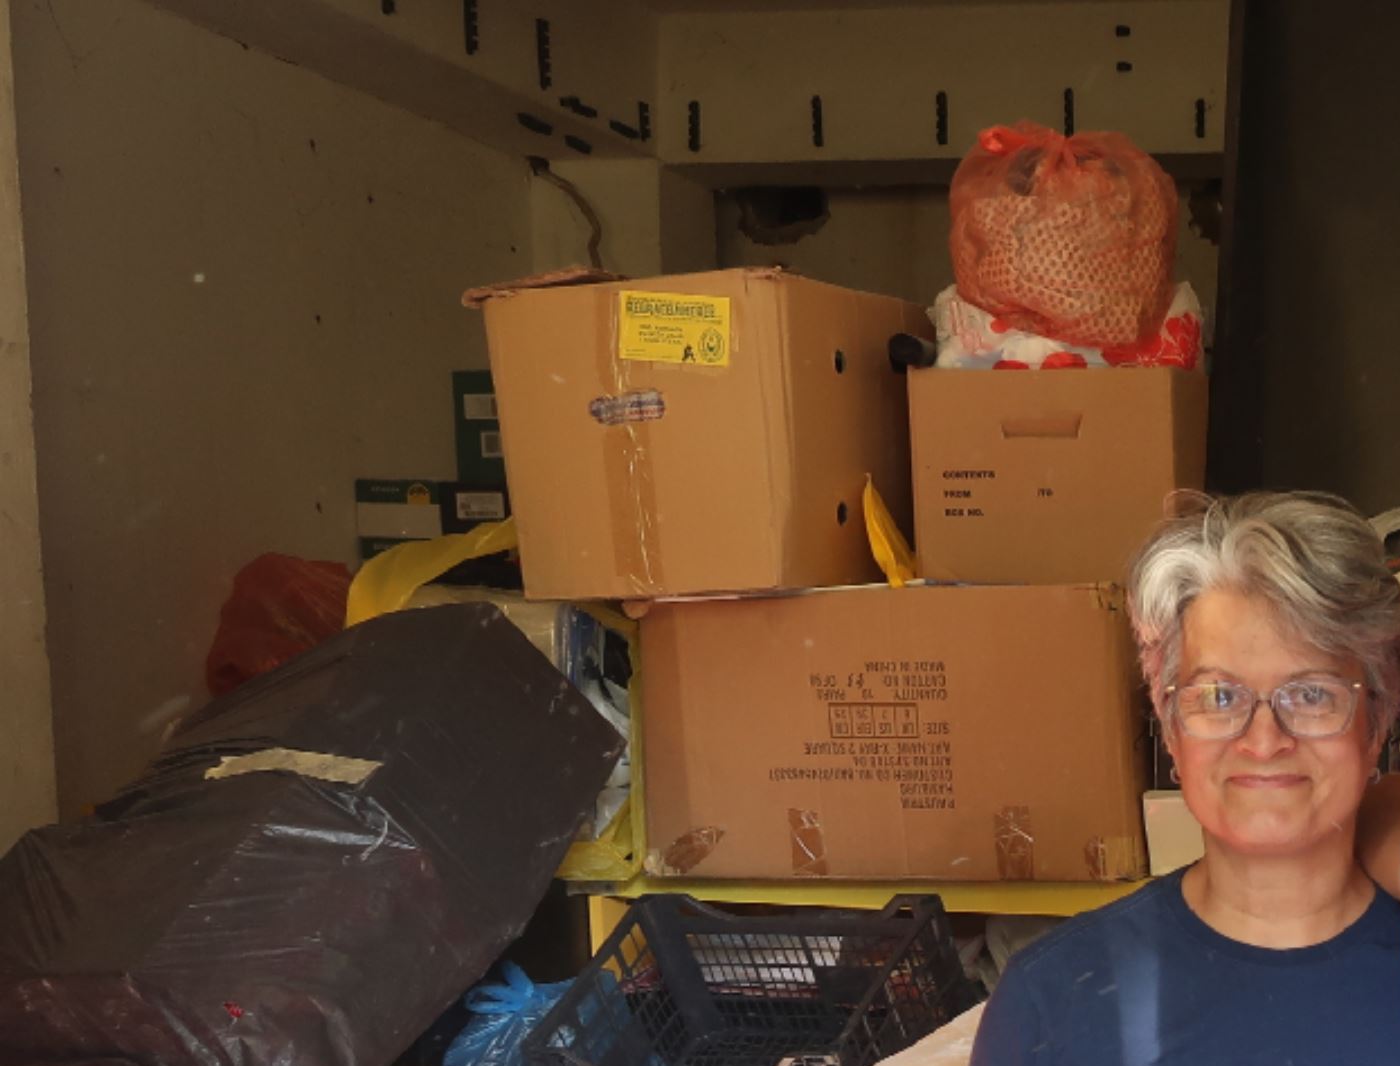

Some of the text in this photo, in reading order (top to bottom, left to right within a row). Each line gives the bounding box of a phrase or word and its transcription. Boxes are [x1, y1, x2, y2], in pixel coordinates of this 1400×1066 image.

[944, 490, 971, 498] FROM
[865, 661, 945, 673] MADE IN CHINA
[901, 674, 946, 687] CARTON
[803, 742, 846, 755] SQUARE
